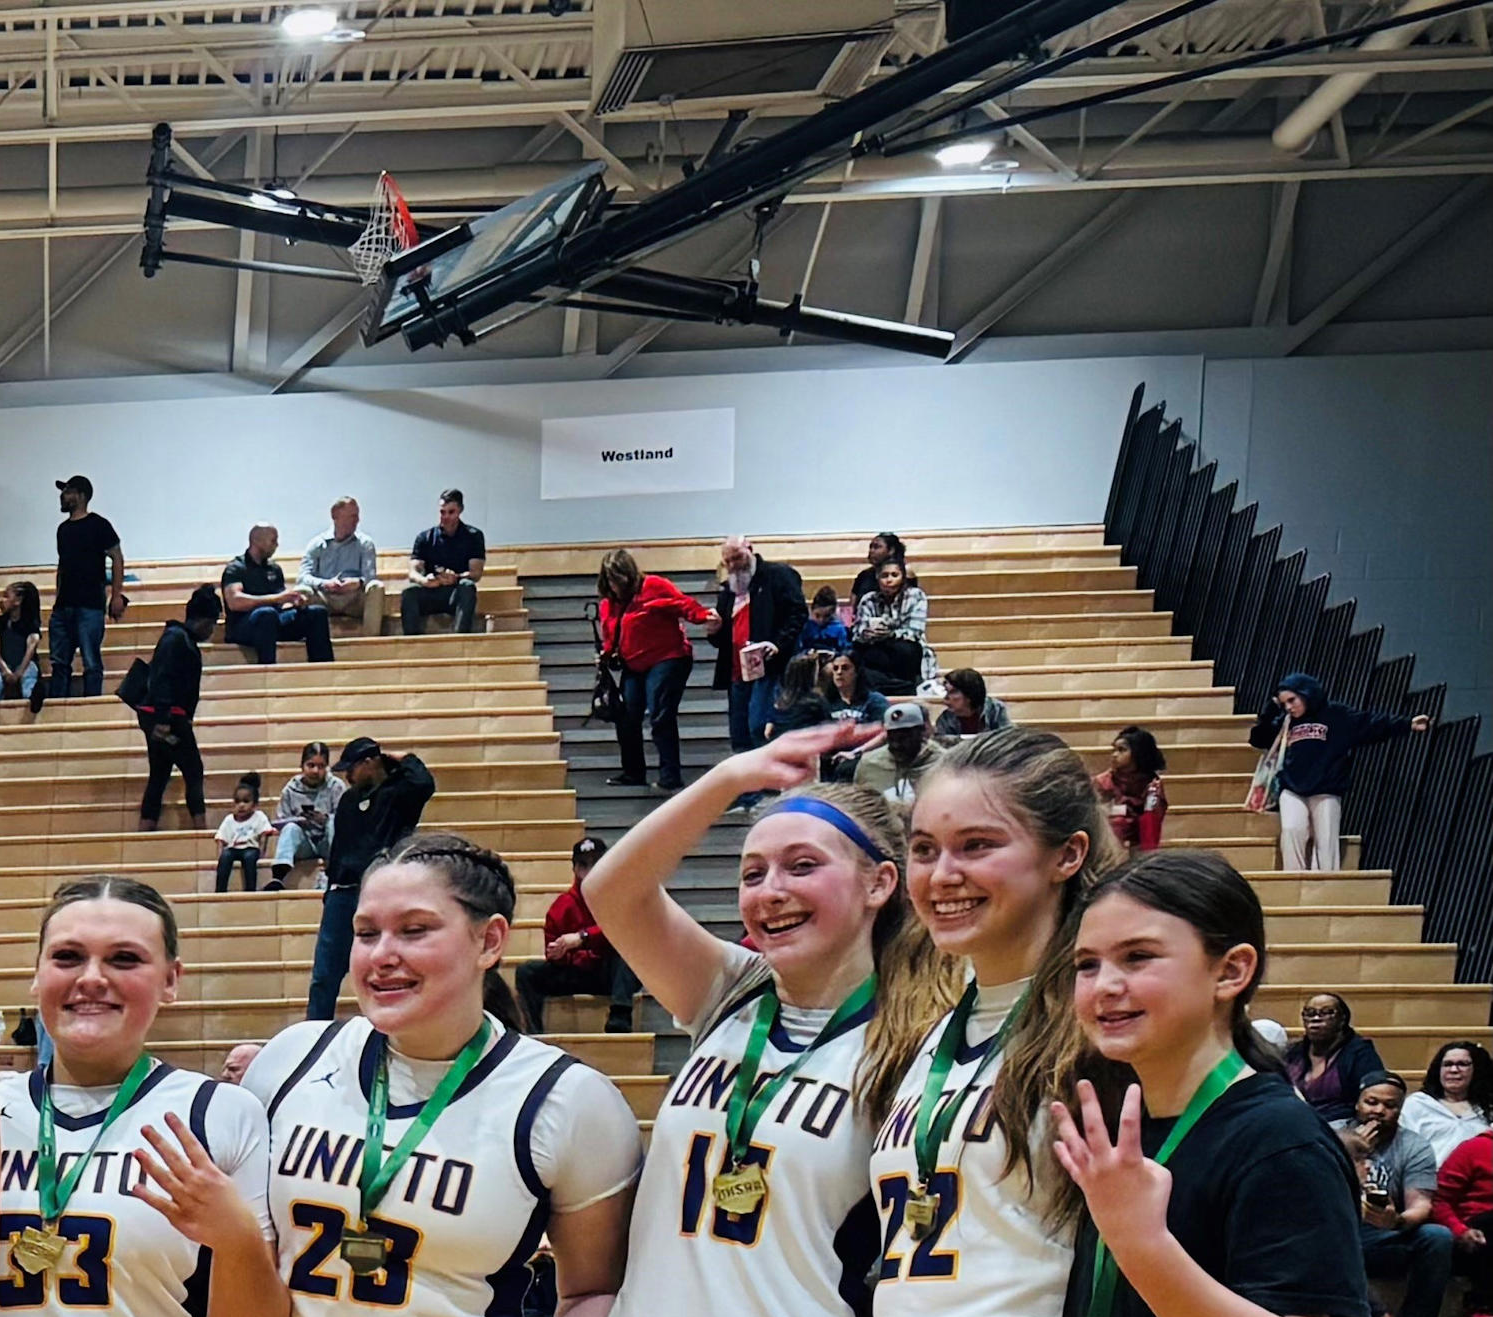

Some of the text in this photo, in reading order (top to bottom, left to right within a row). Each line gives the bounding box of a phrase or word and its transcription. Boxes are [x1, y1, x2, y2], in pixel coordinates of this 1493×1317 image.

[601, 447, 673, 462] Westland
[671, 1056, 849, 1139] UNTO
[874, 1085, 992, 1152] NITO
[1, 1150, 147, 1197] NOTO
[278, 1125, 473, 1216] UNITO
[288, 1199, 425, 1310] 23
[879, 1166, 964, 1283] 22
